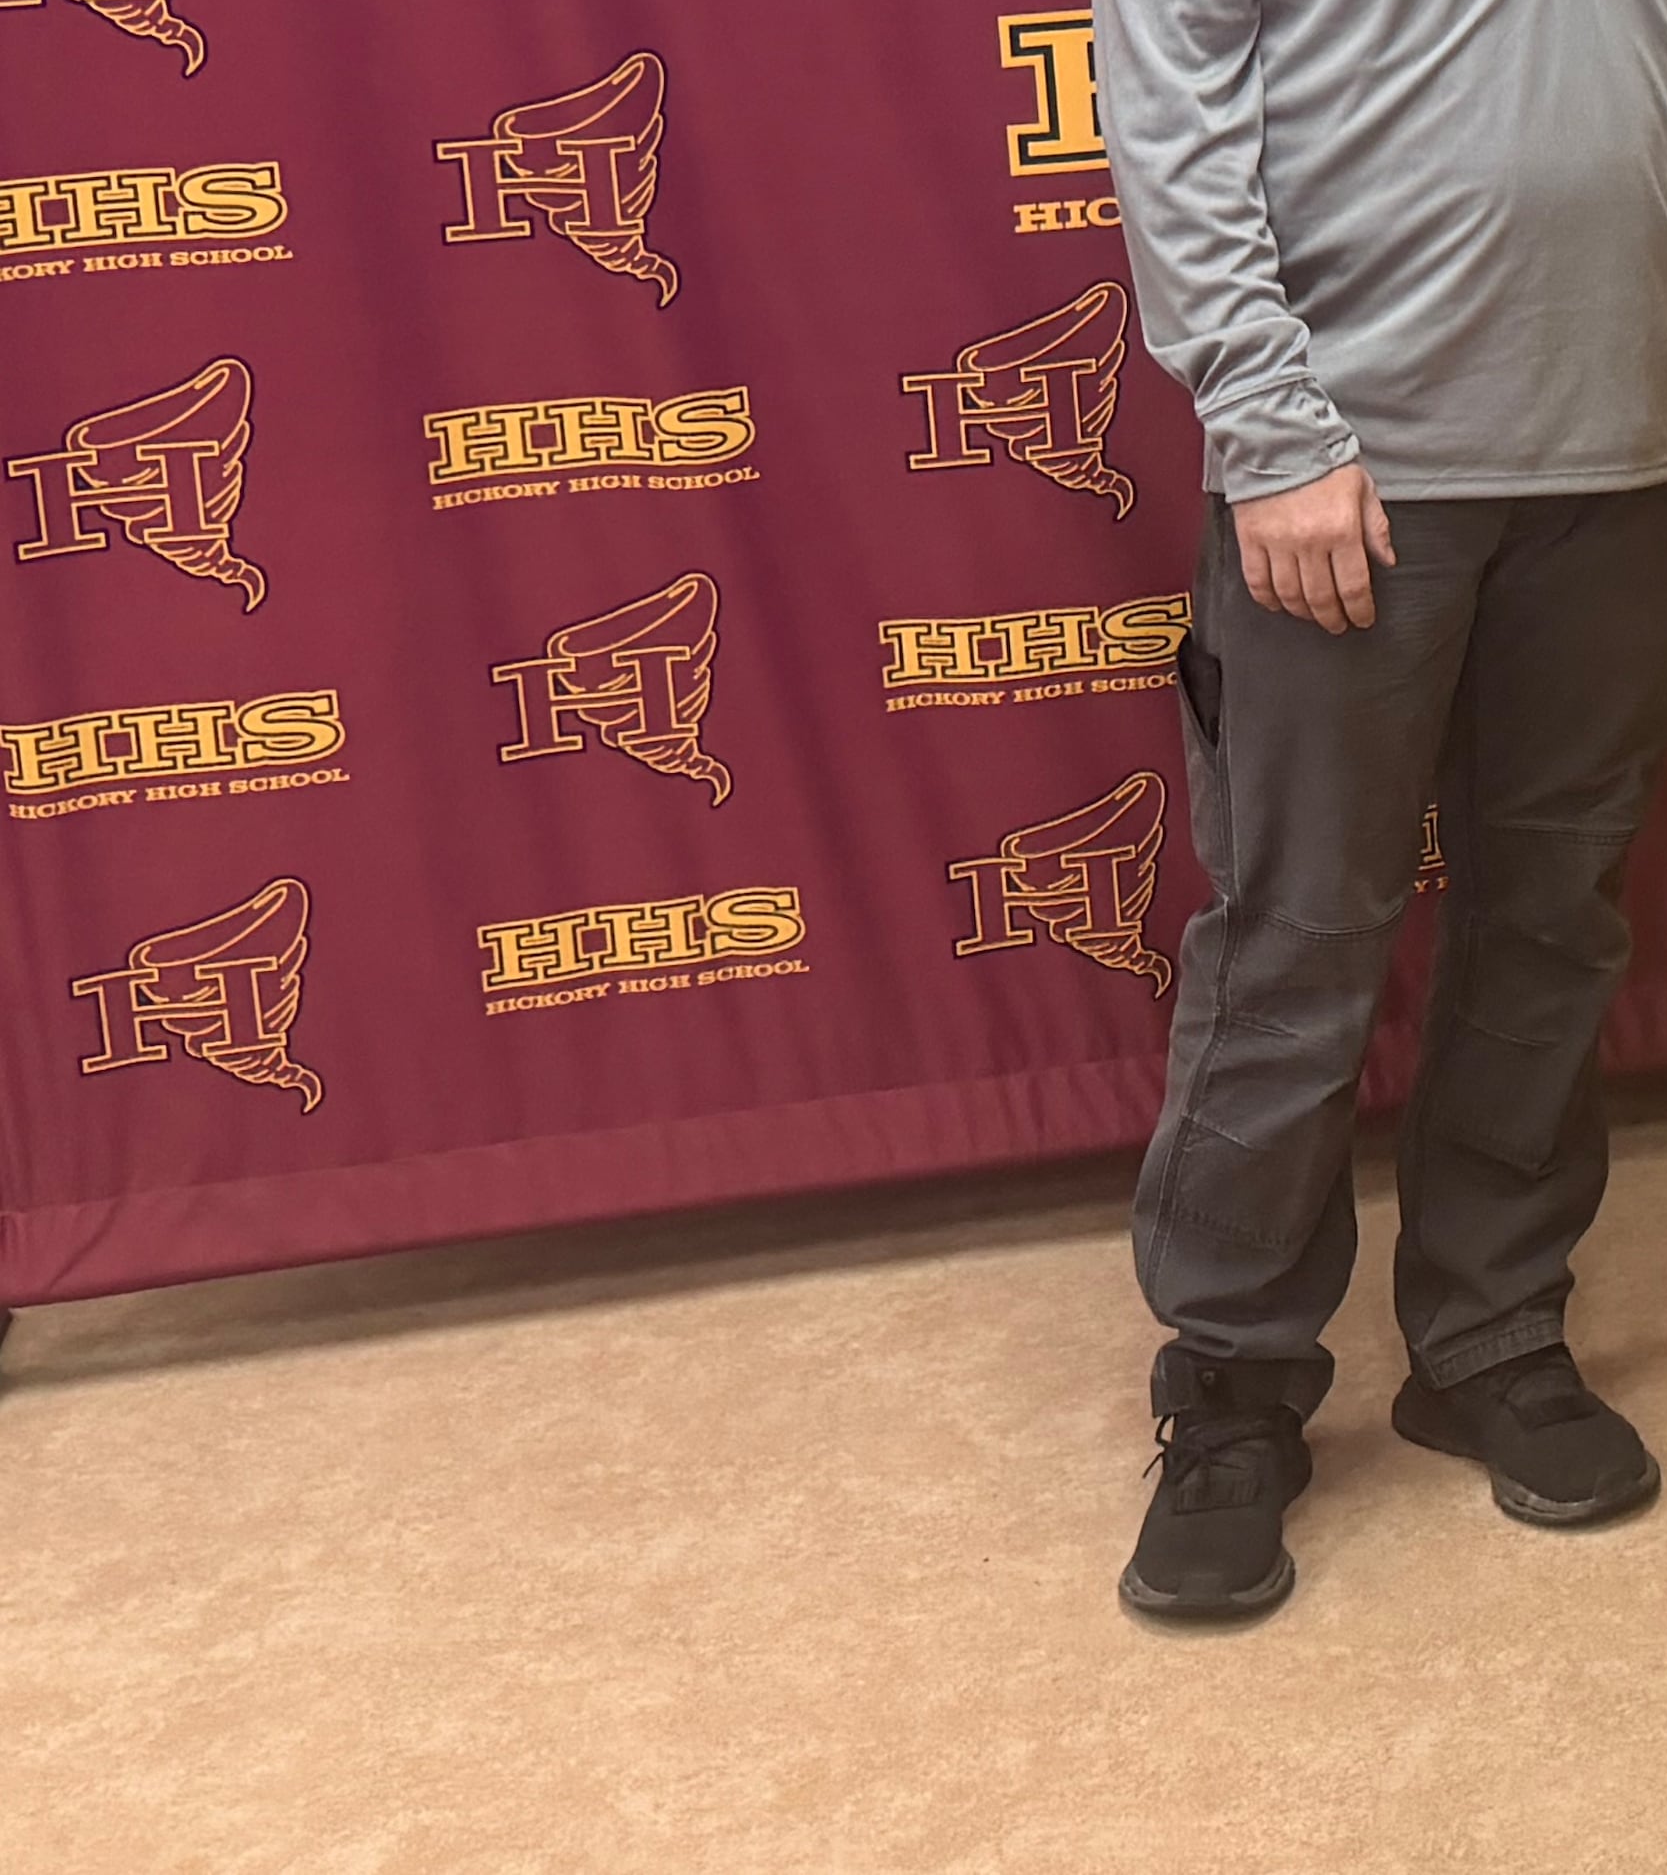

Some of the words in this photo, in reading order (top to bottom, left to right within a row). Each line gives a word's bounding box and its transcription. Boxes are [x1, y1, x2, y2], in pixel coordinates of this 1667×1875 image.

[0, 260, 75, 282] KORY
[83, 254, 164, 274] HIGH
[169, 246, 293, 268] SCHOOL
[423, 385, 756, 485] HHS
[432, 478, 561, 510] HICKORY
[568, 473, 642, 493] HIGH
[647, 466, 761, 490] SCHOOL
[878, 591, 1192, 691] HHS
[886, 688, 1005, 713] HICKORY
[1012, 681, 1085, 704] HIGH
[0, 689, 346, 795] HHS
[9, 789, 137, 819] HICKORY
[145, 779, 221, 803] HIGH
[228, 767, 351, 796] SCHOOL
[476, 887, 806, 993] HHS
[485, 982, 611, 1016] HICKORY
[618, 974, 693, 994] HIGH
[697, 959, 811, 986] SCHOOL
